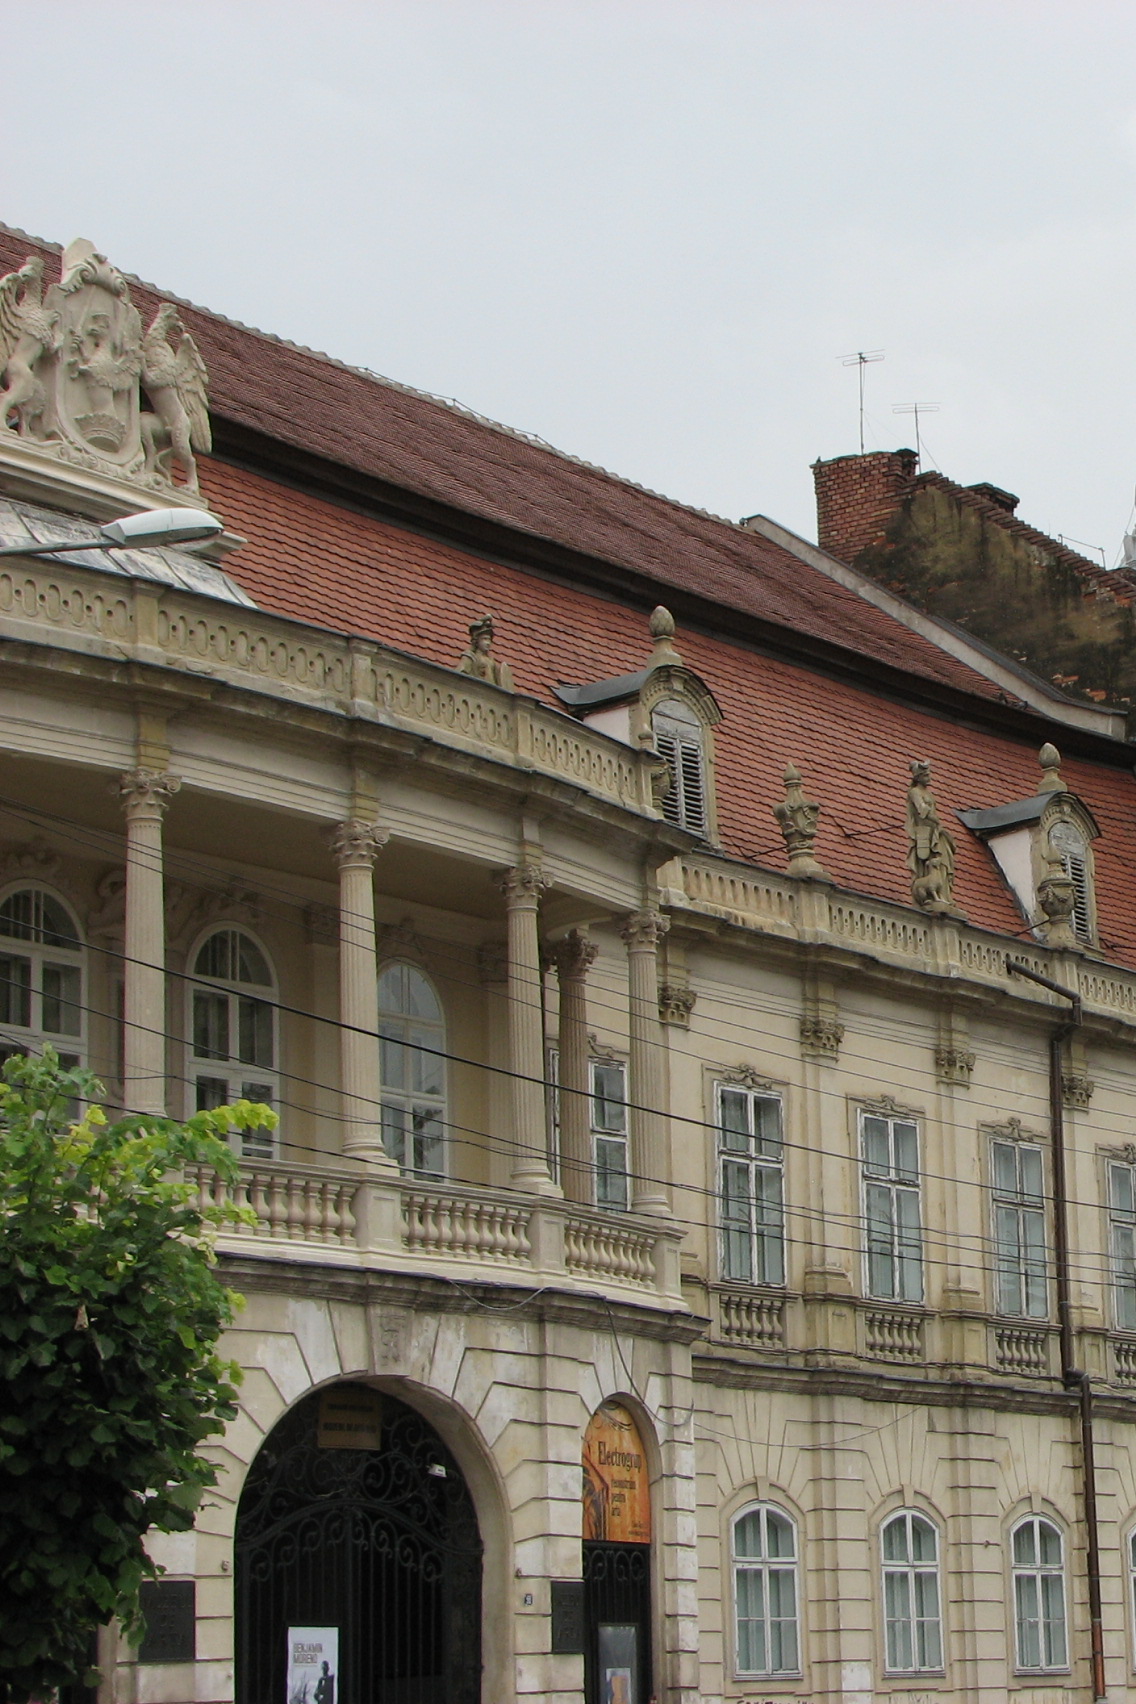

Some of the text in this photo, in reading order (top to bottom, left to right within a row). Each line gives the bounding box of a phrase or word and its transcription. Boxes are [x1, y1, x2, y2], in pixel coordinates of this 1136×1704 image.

[598, 1441, 642, 1473] Electrogrup
[294, 1643, 323, 1653] BENJAMIN
[293, 1653, 318, 1664] MORENO
